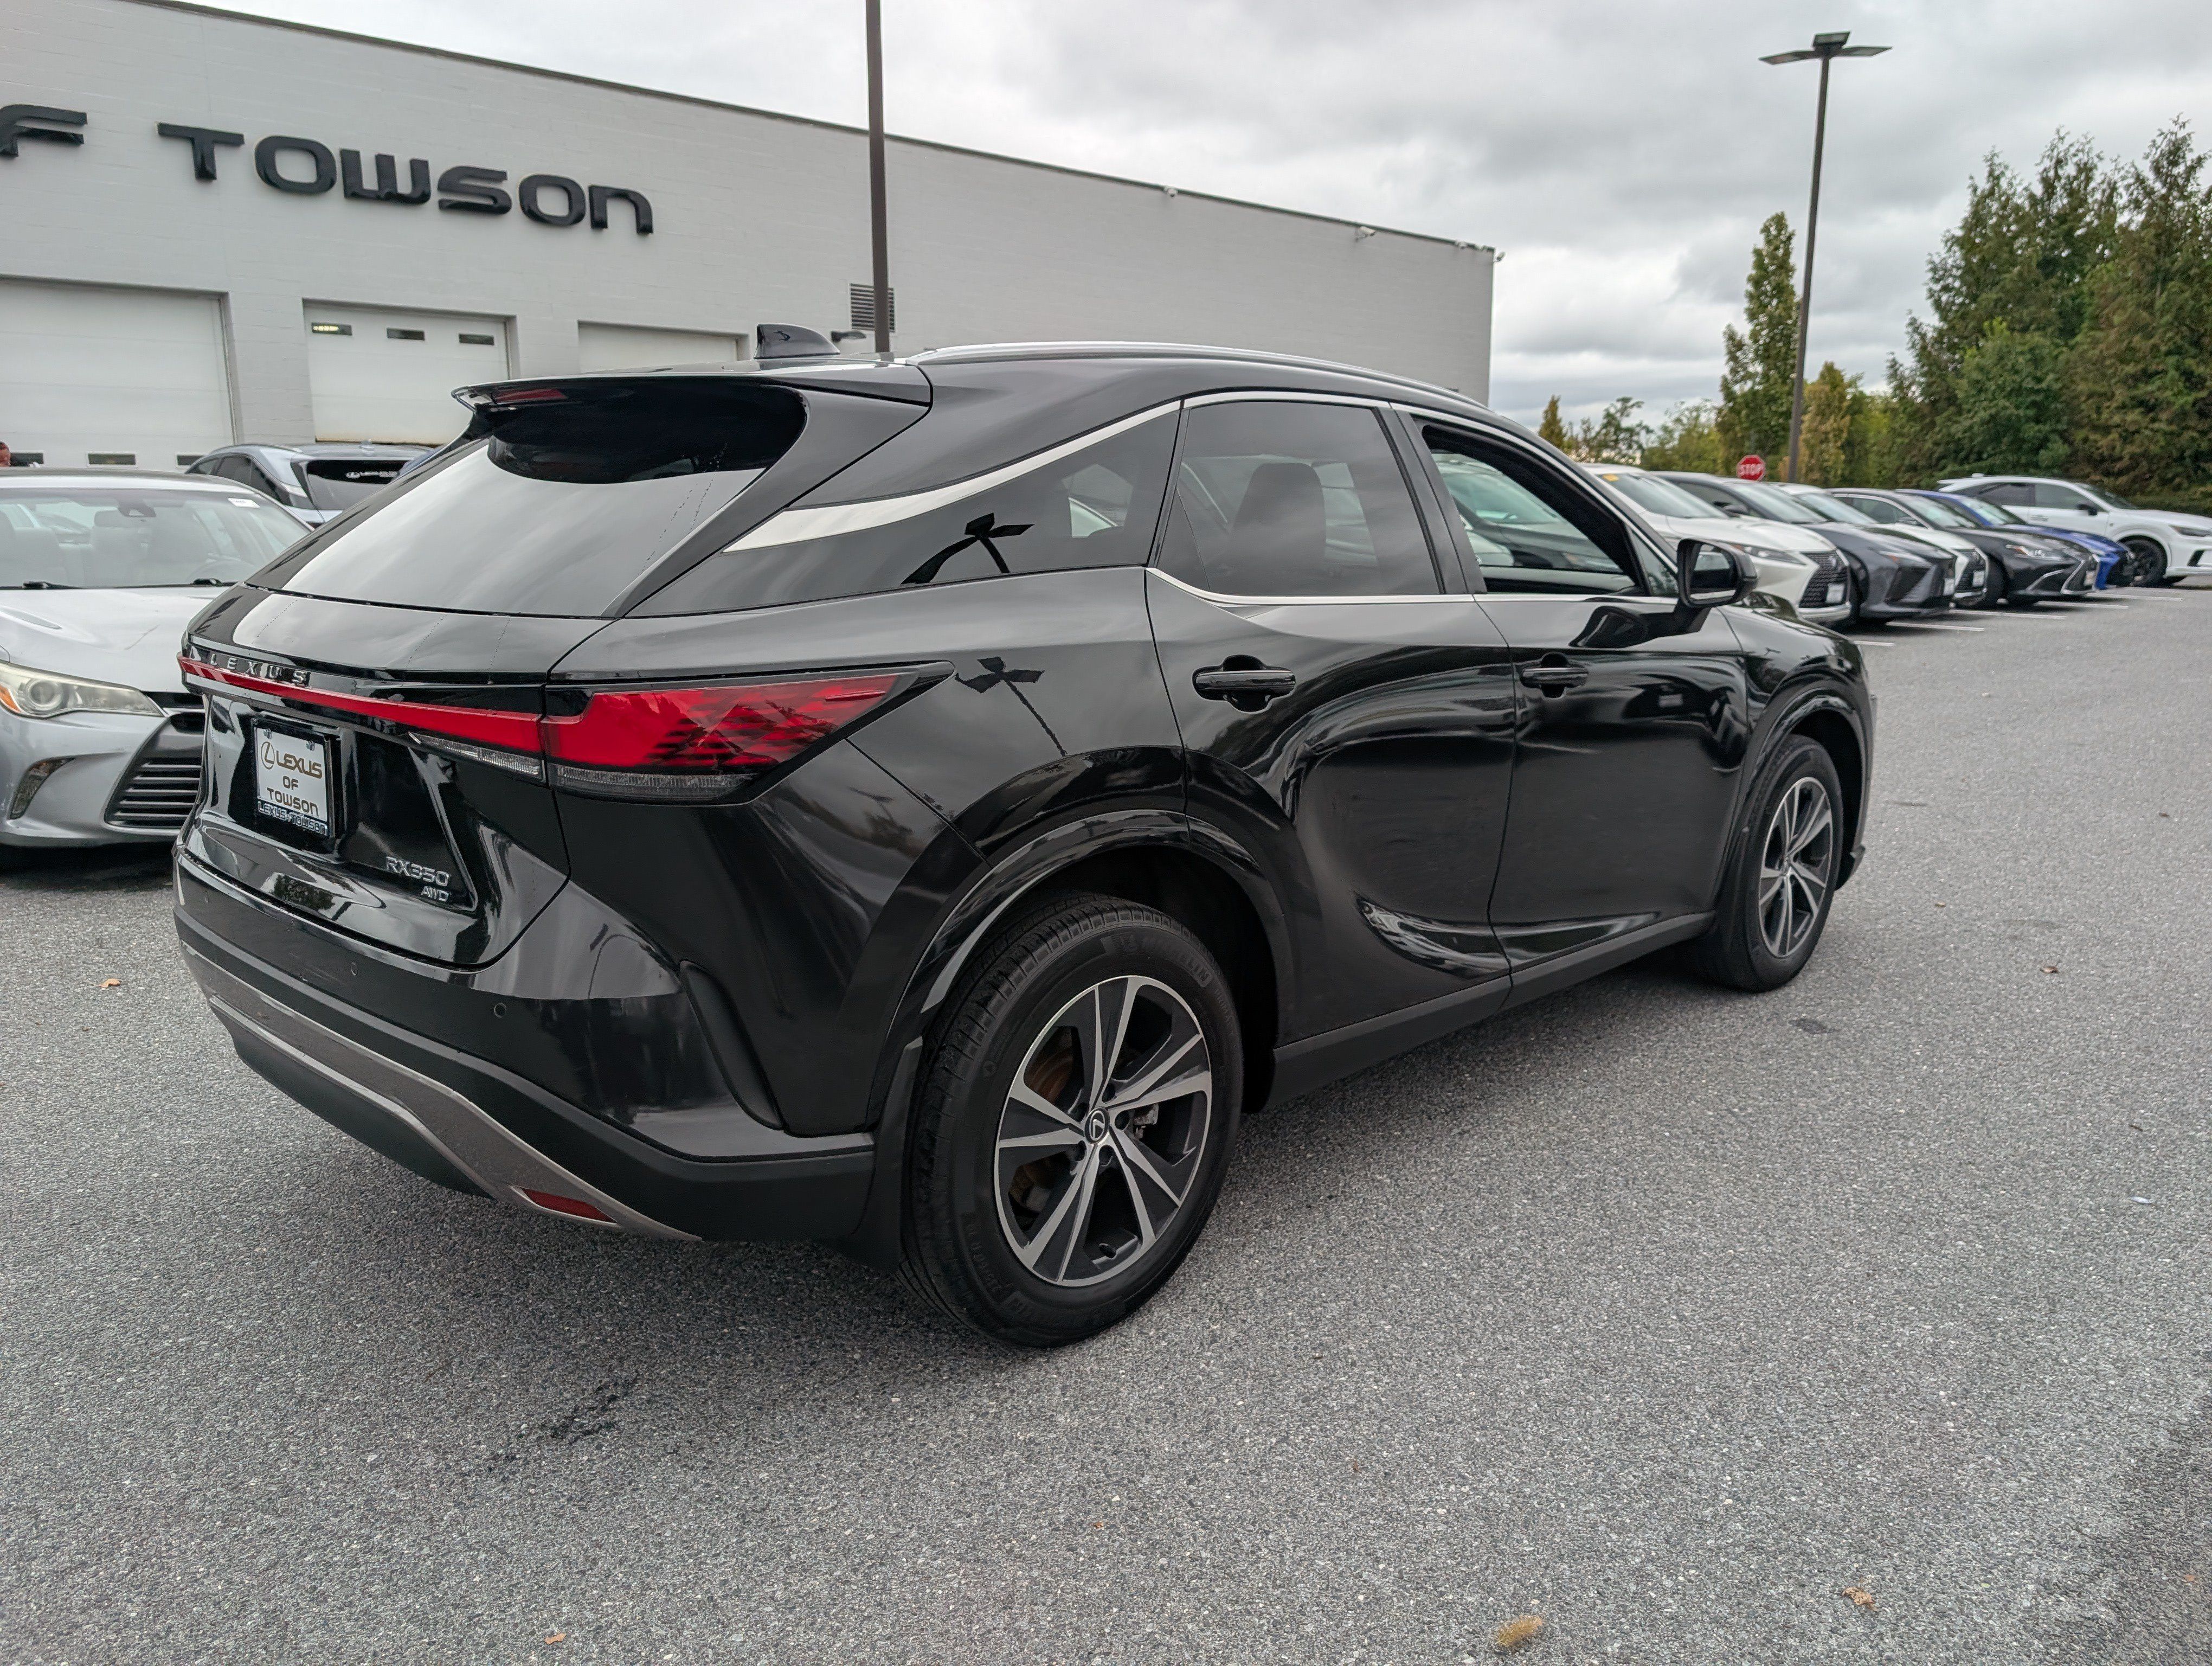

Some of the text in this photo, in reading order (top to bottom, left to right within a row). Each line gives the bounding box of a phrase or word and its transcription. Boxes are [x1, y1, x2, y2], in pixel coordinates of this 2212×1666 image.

[156, 121, 654, 235] TOWSON
[1739, 464, 1763, 476] STOP
[210, 653, 306, 684] LEXUS
[276, 750, 323, 779] LEXUS
[282, 776, 299, 790] OF
[257, 801, 287, 821] LEXUS
[266, 787, 319, 817] TOWSON
[386, 856, 449, 887] RX350
[421, 886, 449, 902] AWD
